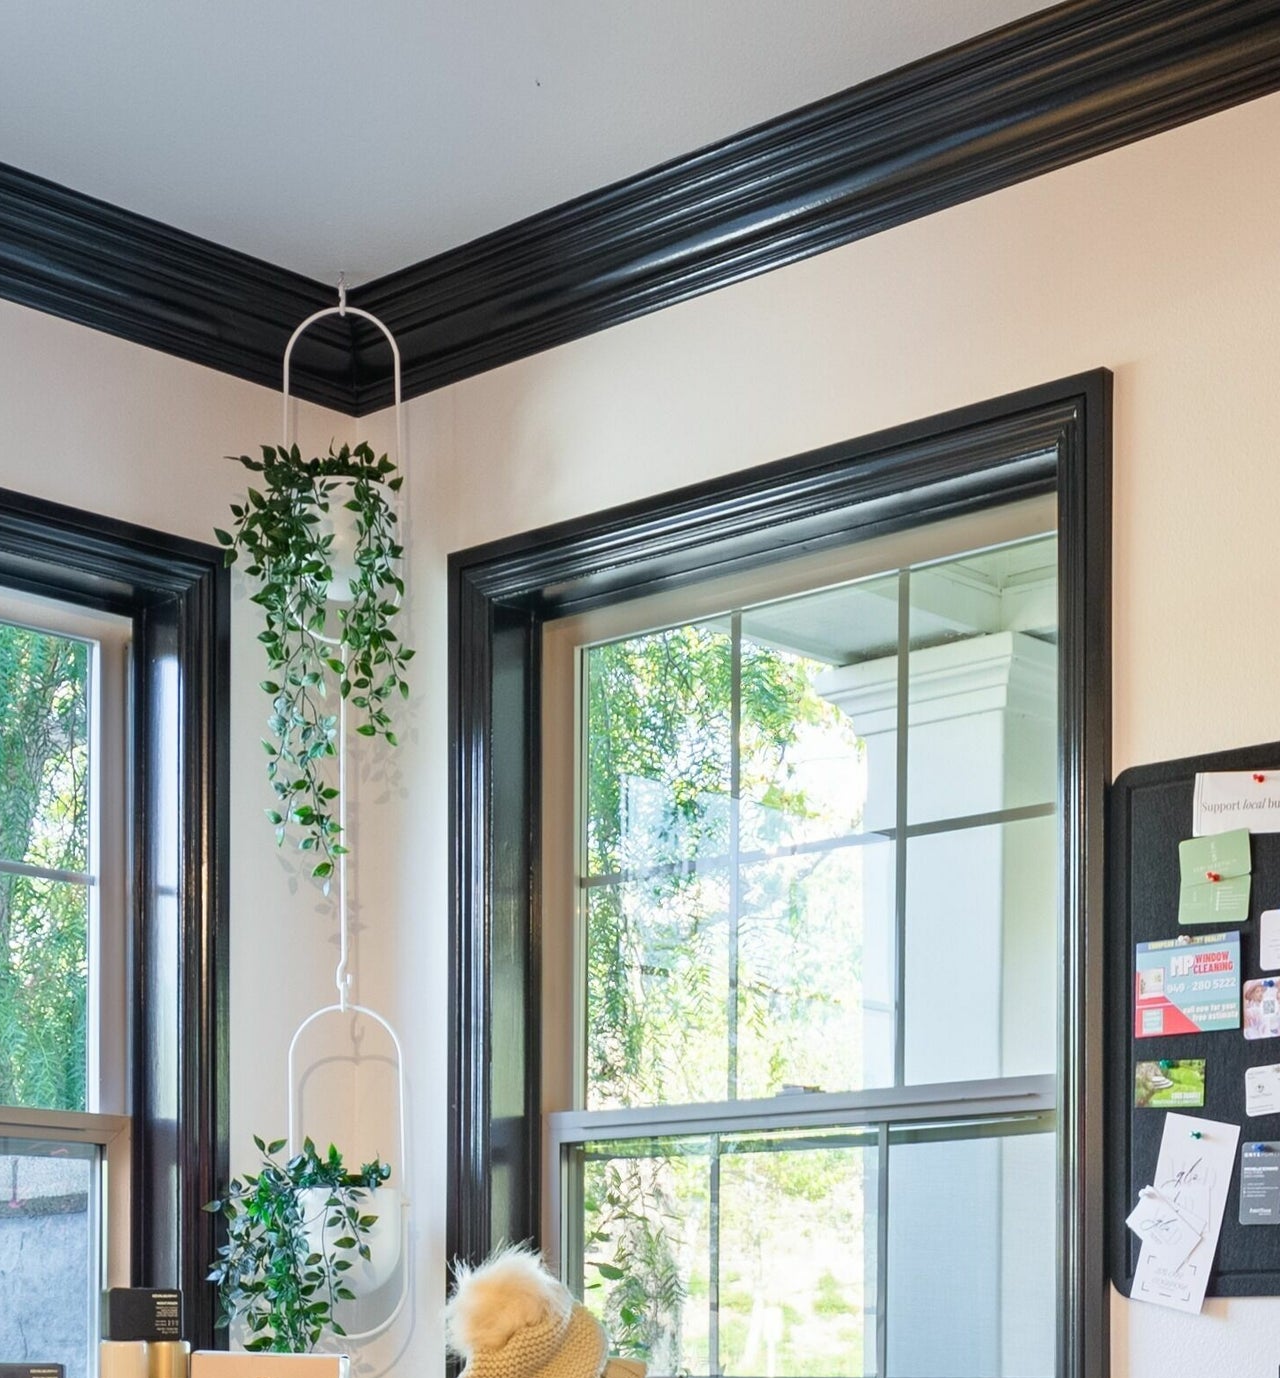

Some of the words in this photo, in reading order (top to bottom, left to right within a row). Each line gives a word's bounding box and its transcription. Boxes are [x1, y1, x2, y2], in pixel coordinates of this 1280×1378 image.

[1201, 800, 1241, 814] Support
[1242, 797, 1267, 811] local
[1195, 951, 1230, 964] WINDOW
[1170, 954, 1195, 977] MP
[1193, 960, 1234, 975] CLEANING
[1192, 979, 1212, 992] 280
